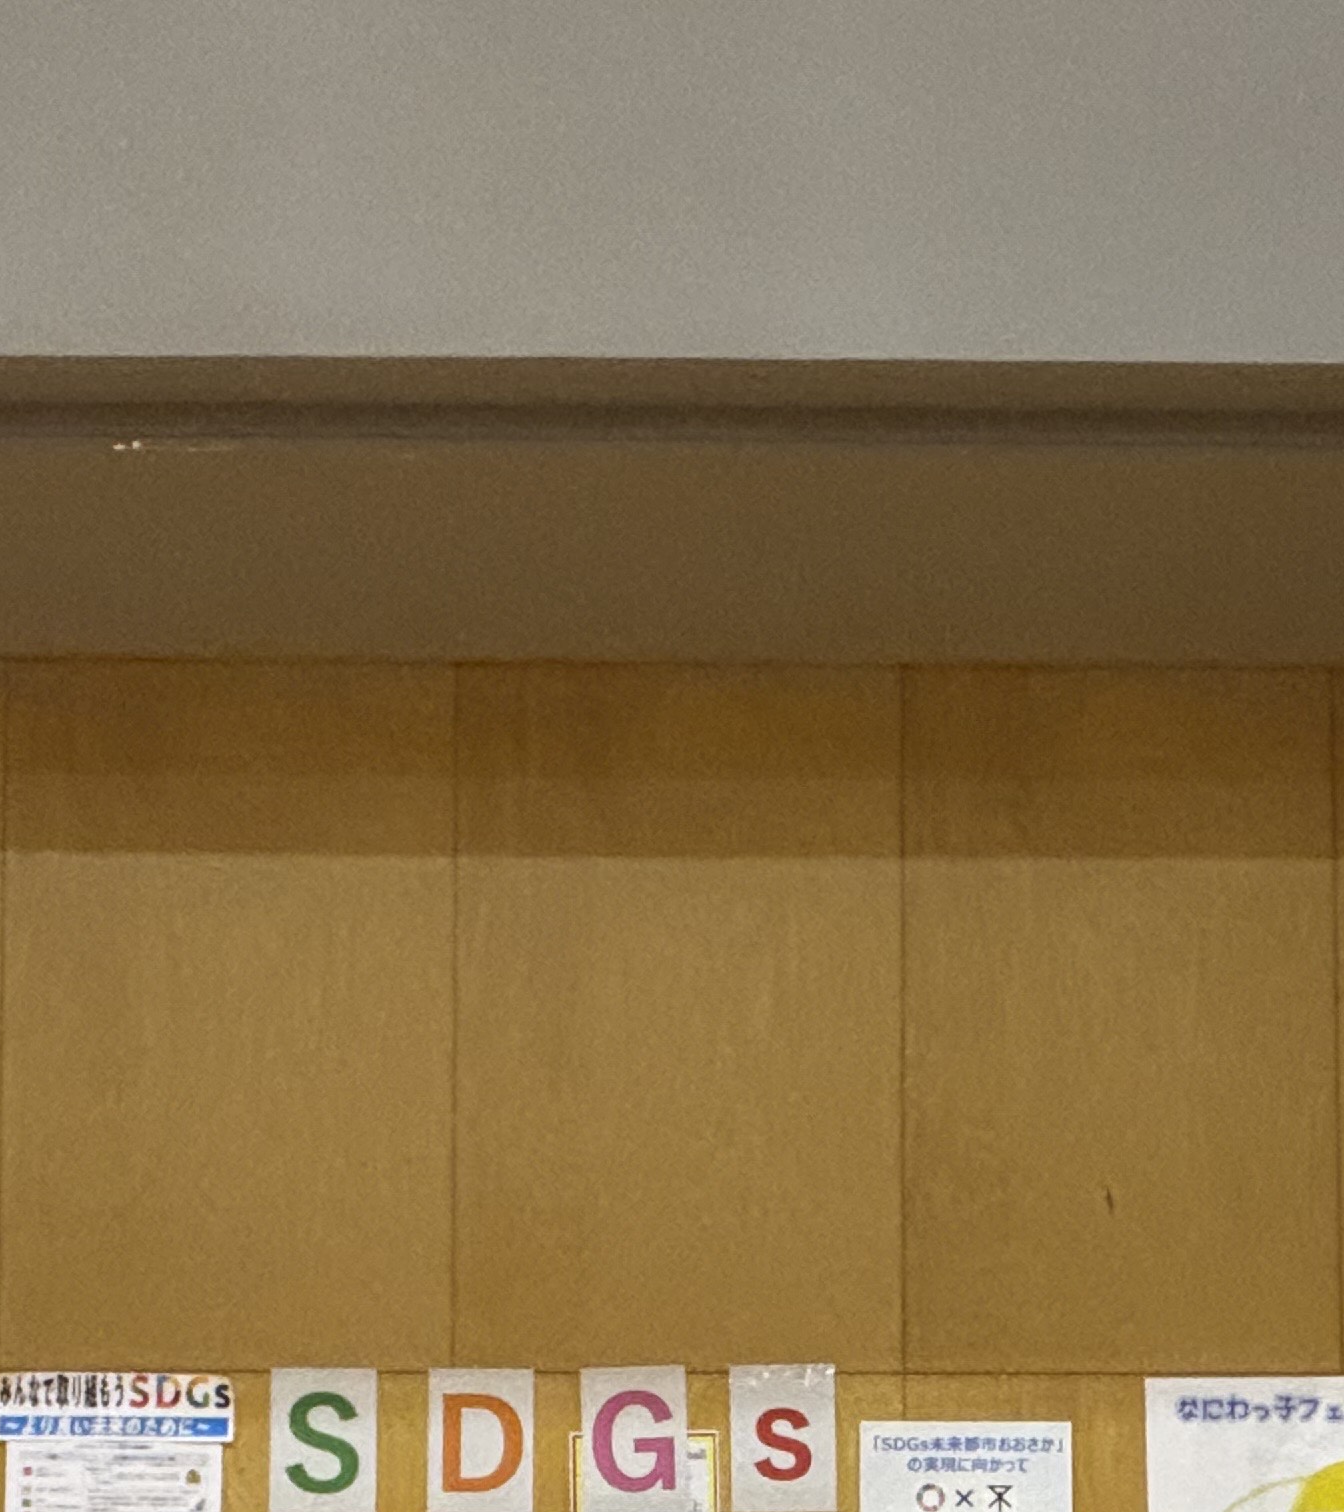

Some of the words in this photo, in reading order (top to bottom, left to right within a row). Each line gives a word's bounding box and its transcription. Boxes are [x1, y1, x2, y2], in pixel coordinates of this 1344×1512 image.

[907, 1457, 1030, 1473] の実現に向かって
